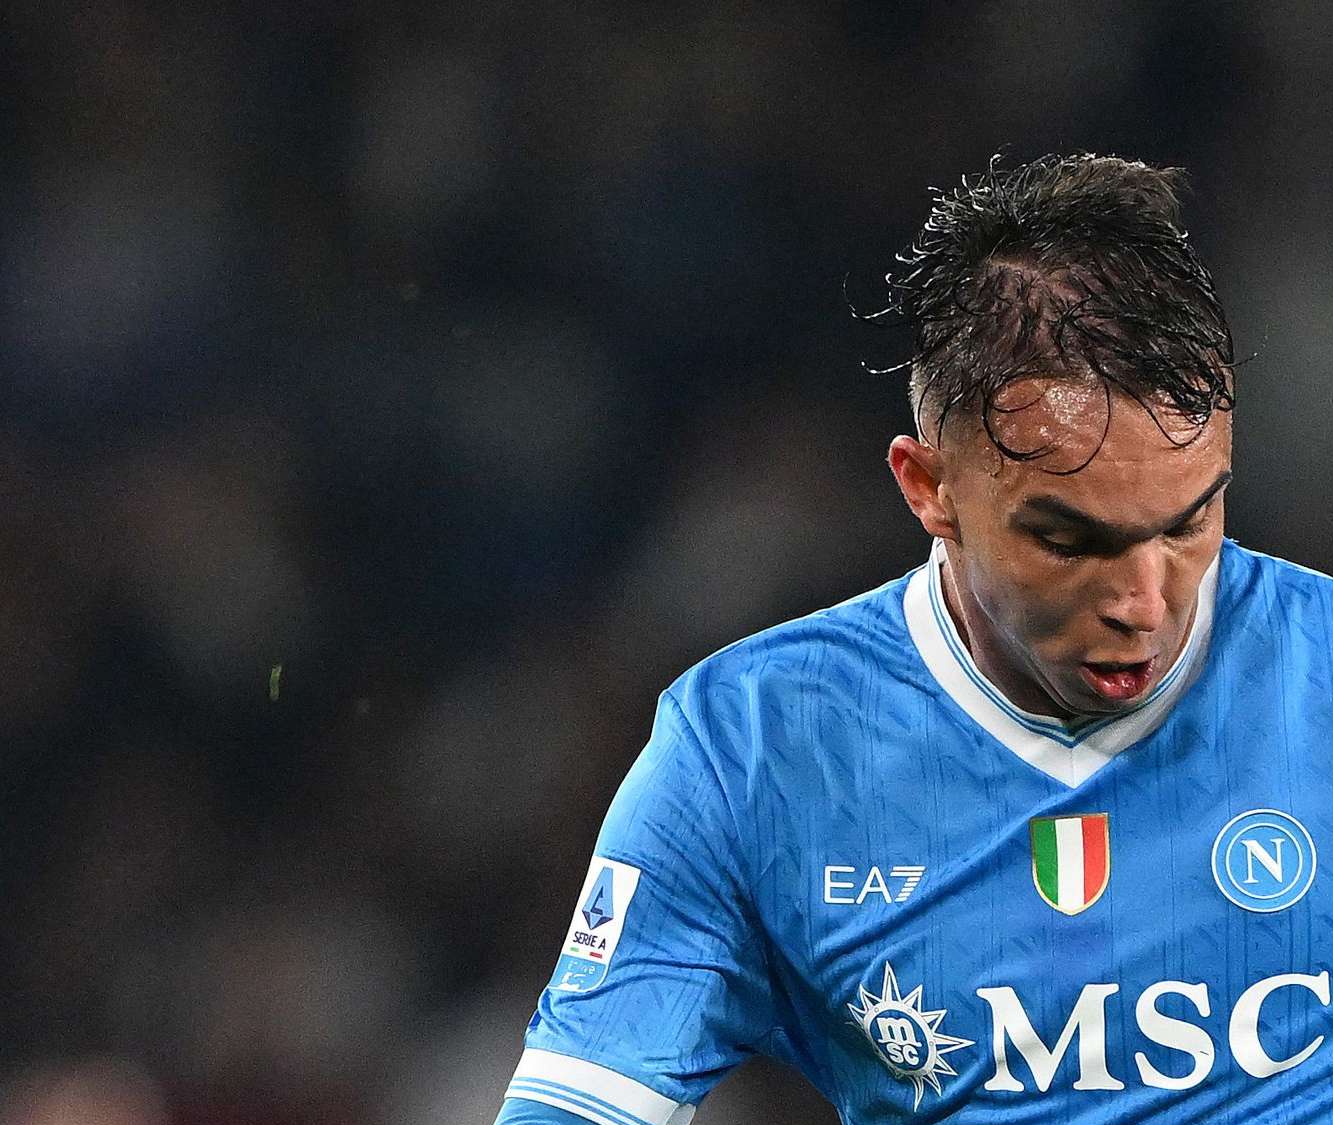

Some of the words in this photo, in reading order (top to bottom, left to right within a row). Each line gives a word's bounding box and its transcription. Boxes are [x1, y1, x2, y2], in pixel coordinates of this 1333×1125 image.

[1242, 837, 1286, 885] N
[823, 865, 927, 905] EA7
[572, 931, 598, 948] SERIE
[598, 938, 607, 951] A
[976, 970, 1331, 1093] MSC
